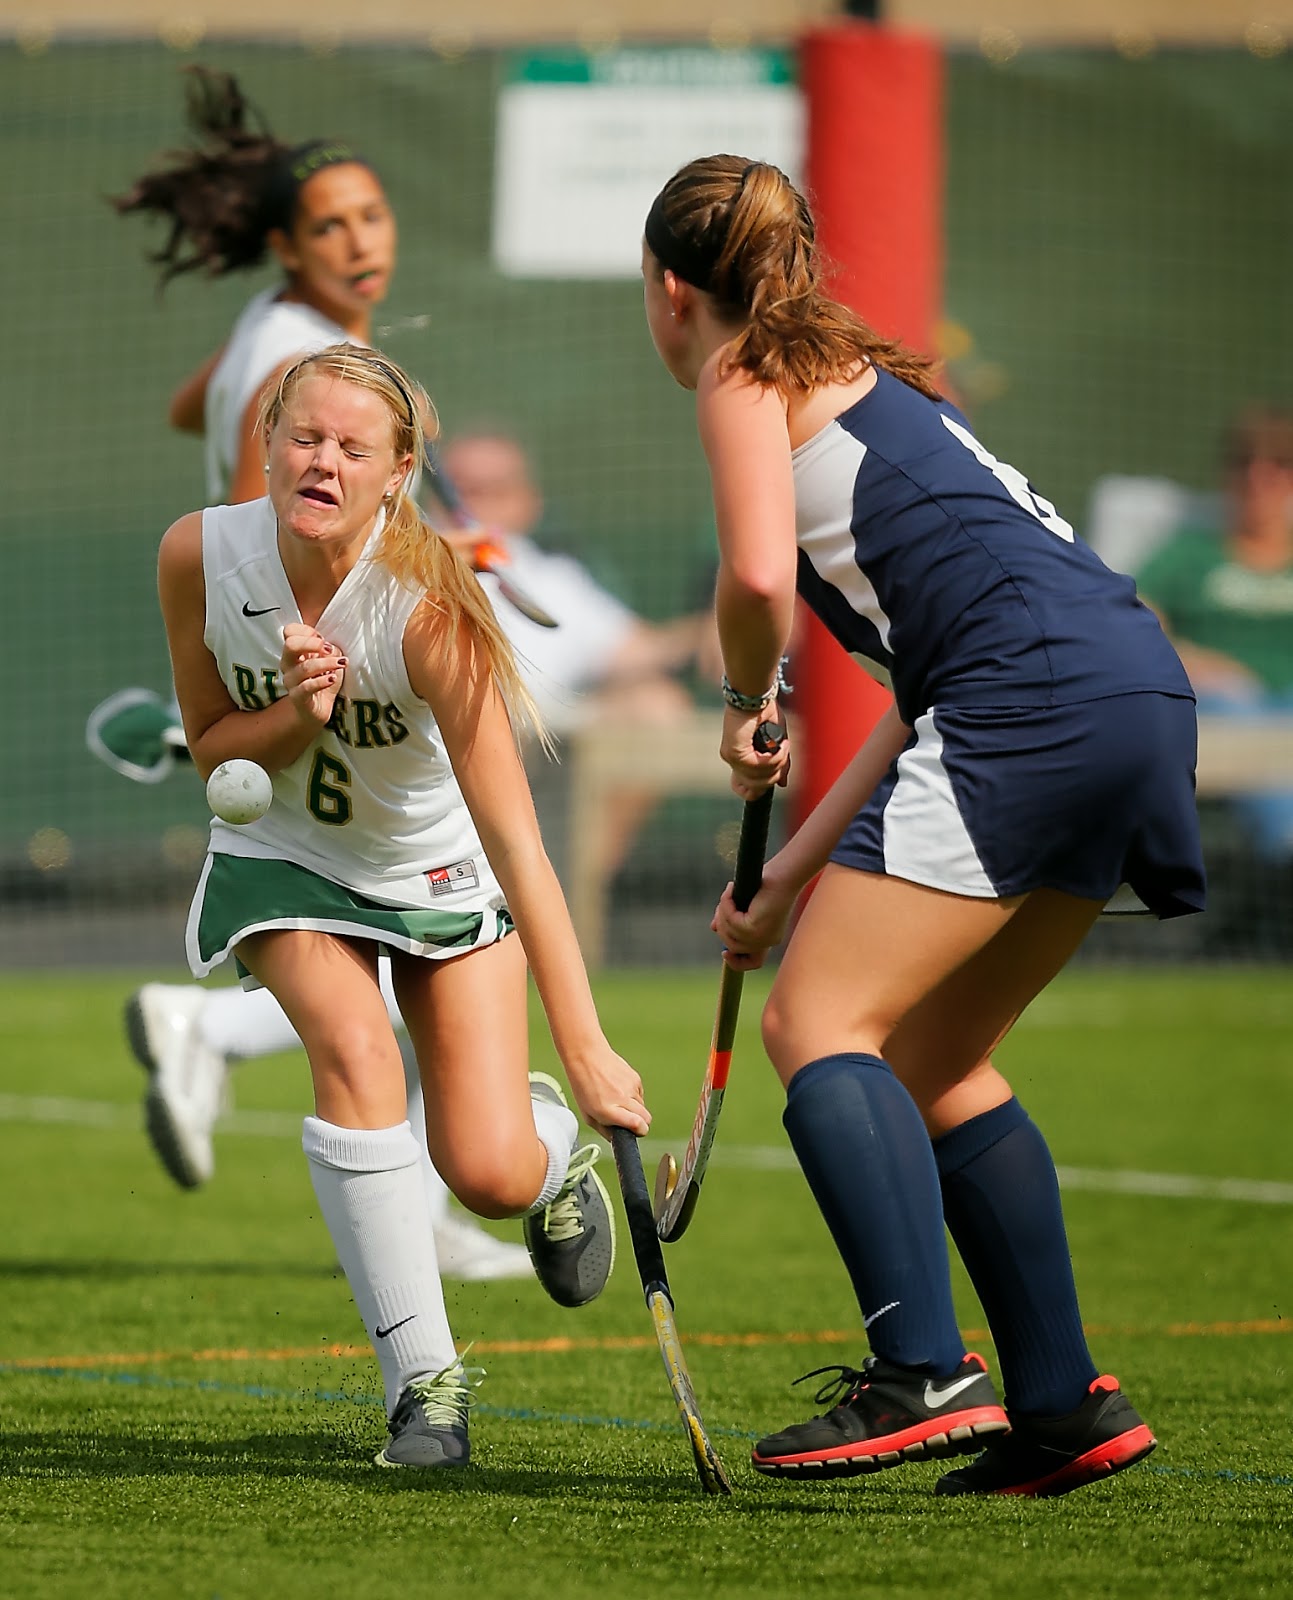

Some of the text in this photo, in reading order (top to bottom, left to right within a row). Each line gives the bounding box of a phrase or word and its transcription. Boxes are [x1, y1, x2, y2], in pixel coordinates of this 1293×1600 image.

[232, 662, 410, 749] RIERS
[306, 746, 354, 827] 6
[456, 867, 465, 877] S
